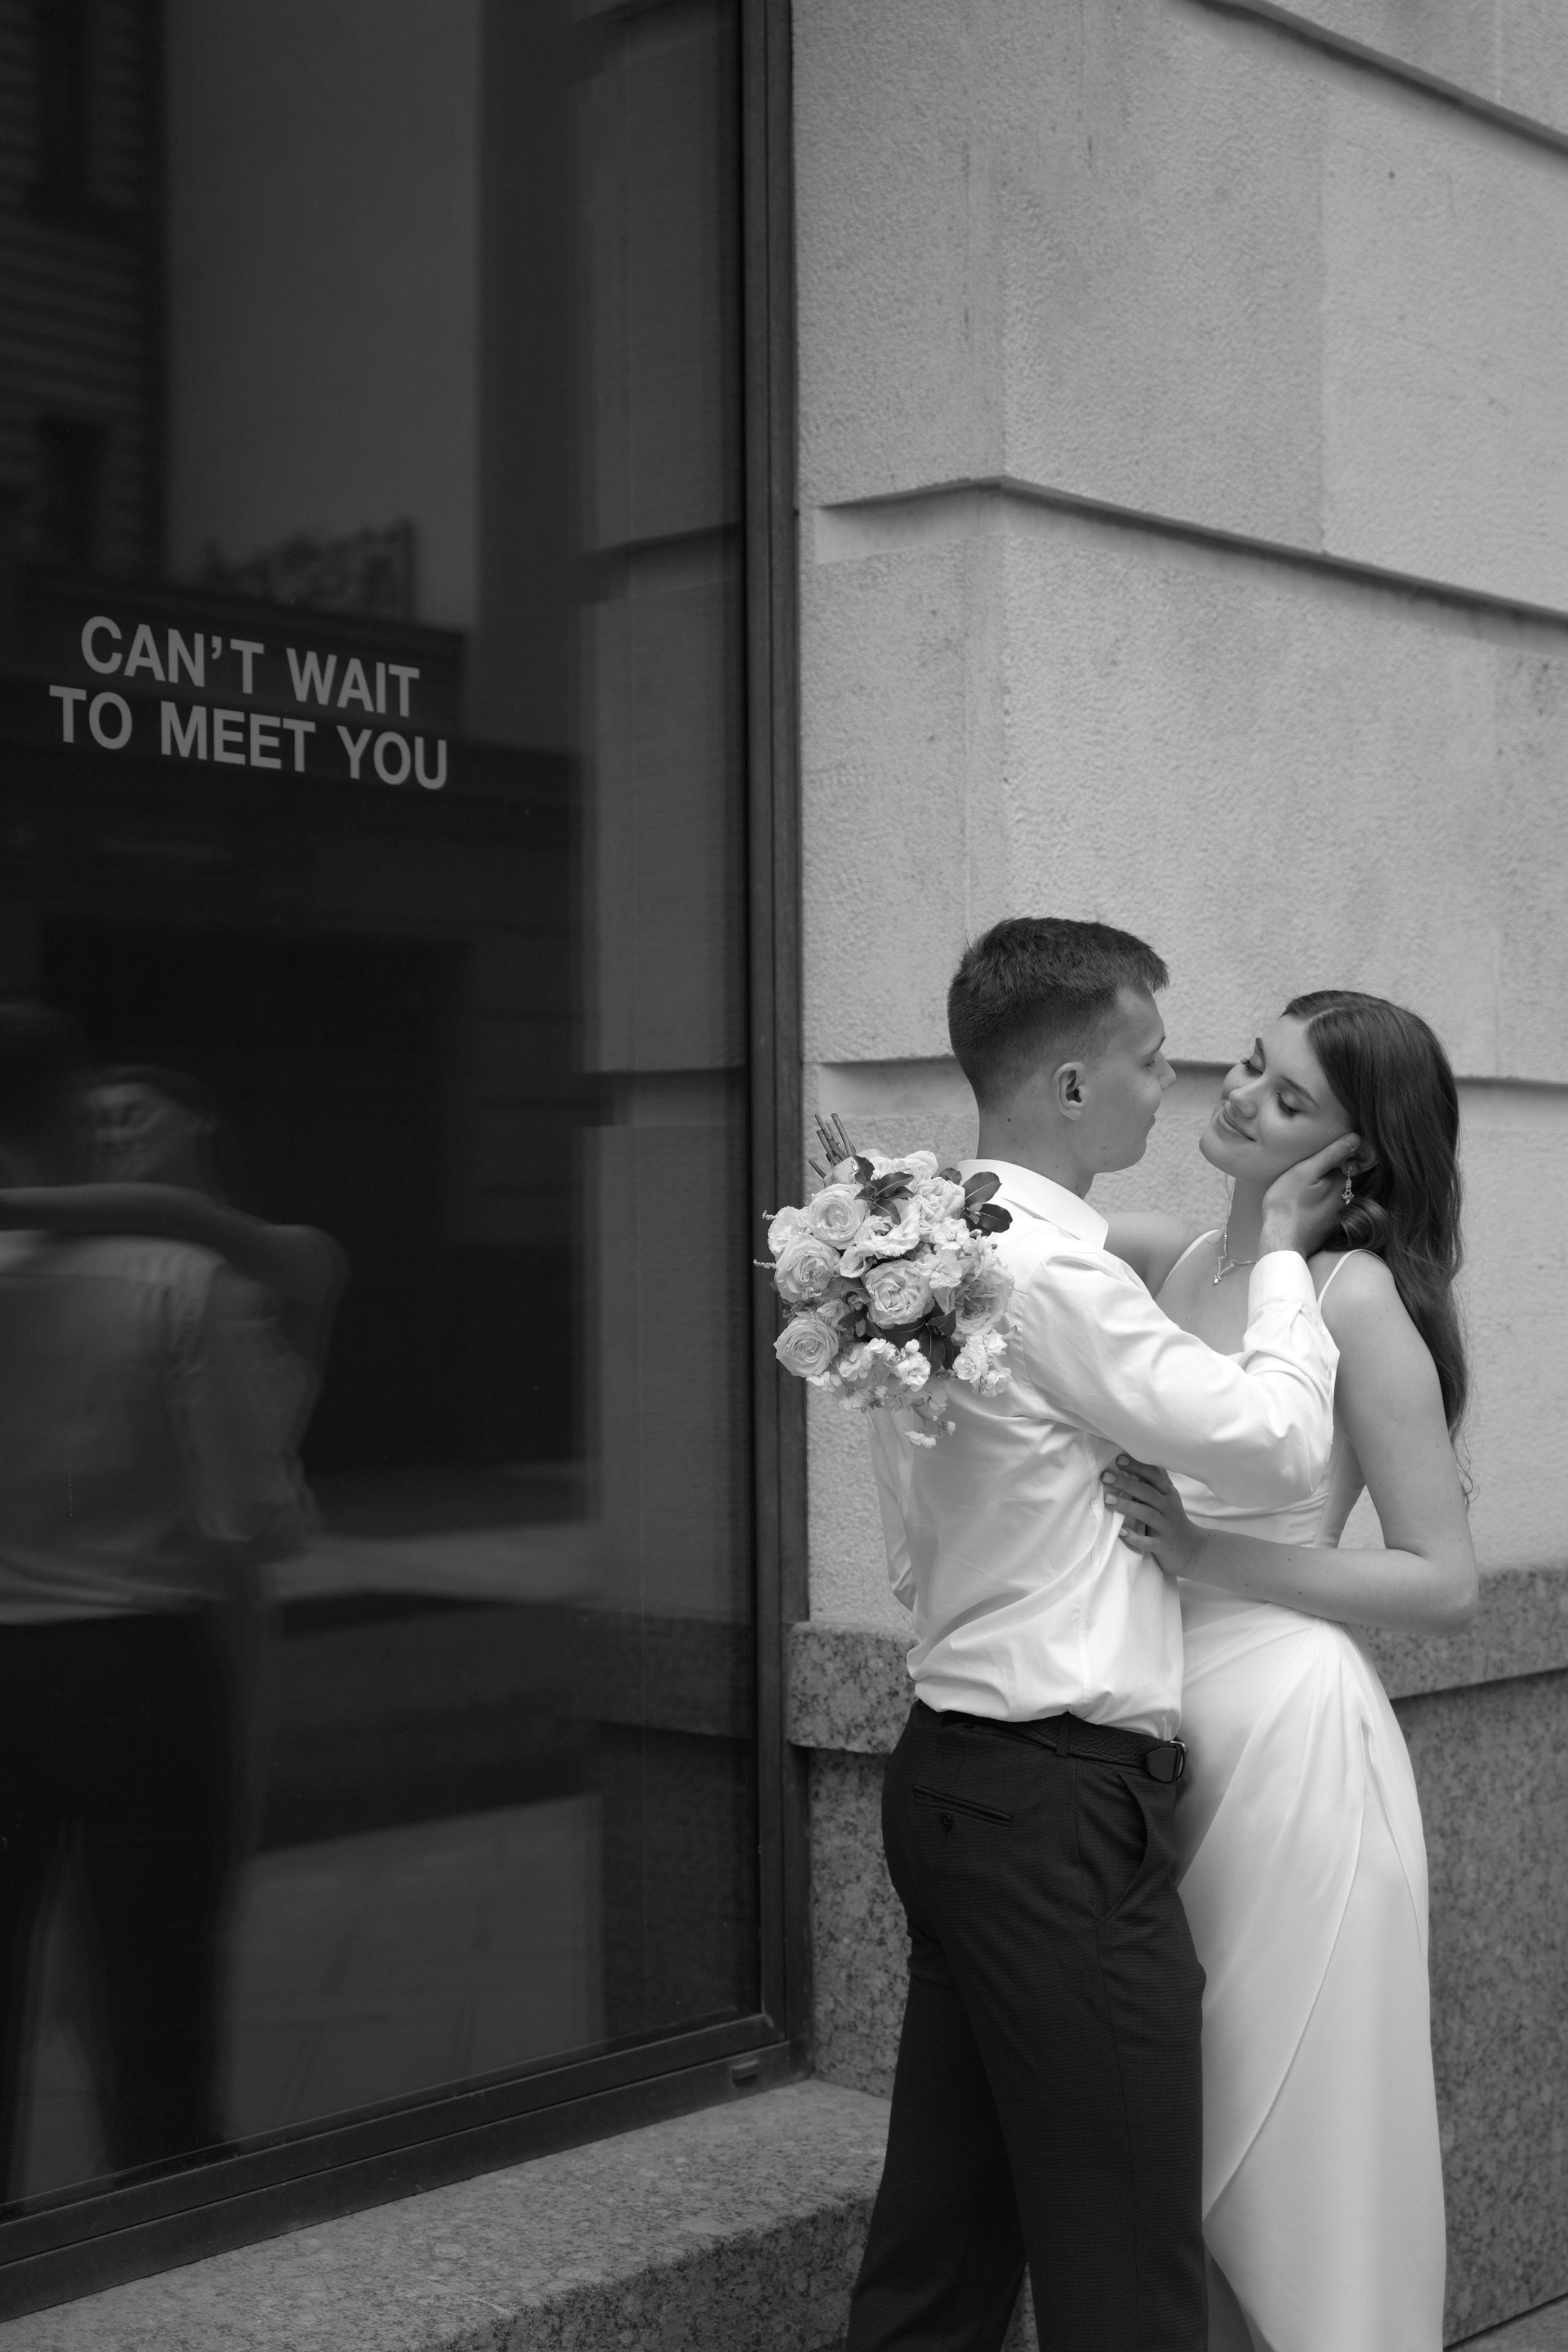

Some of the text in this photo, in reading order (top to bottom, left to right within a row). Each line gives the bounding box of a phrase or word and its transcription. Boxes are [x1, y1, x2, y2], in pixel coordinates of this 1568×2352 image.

[286, 647, 420, 717] WAIT
[49, 684, 447, 790] TO MEET YOU
